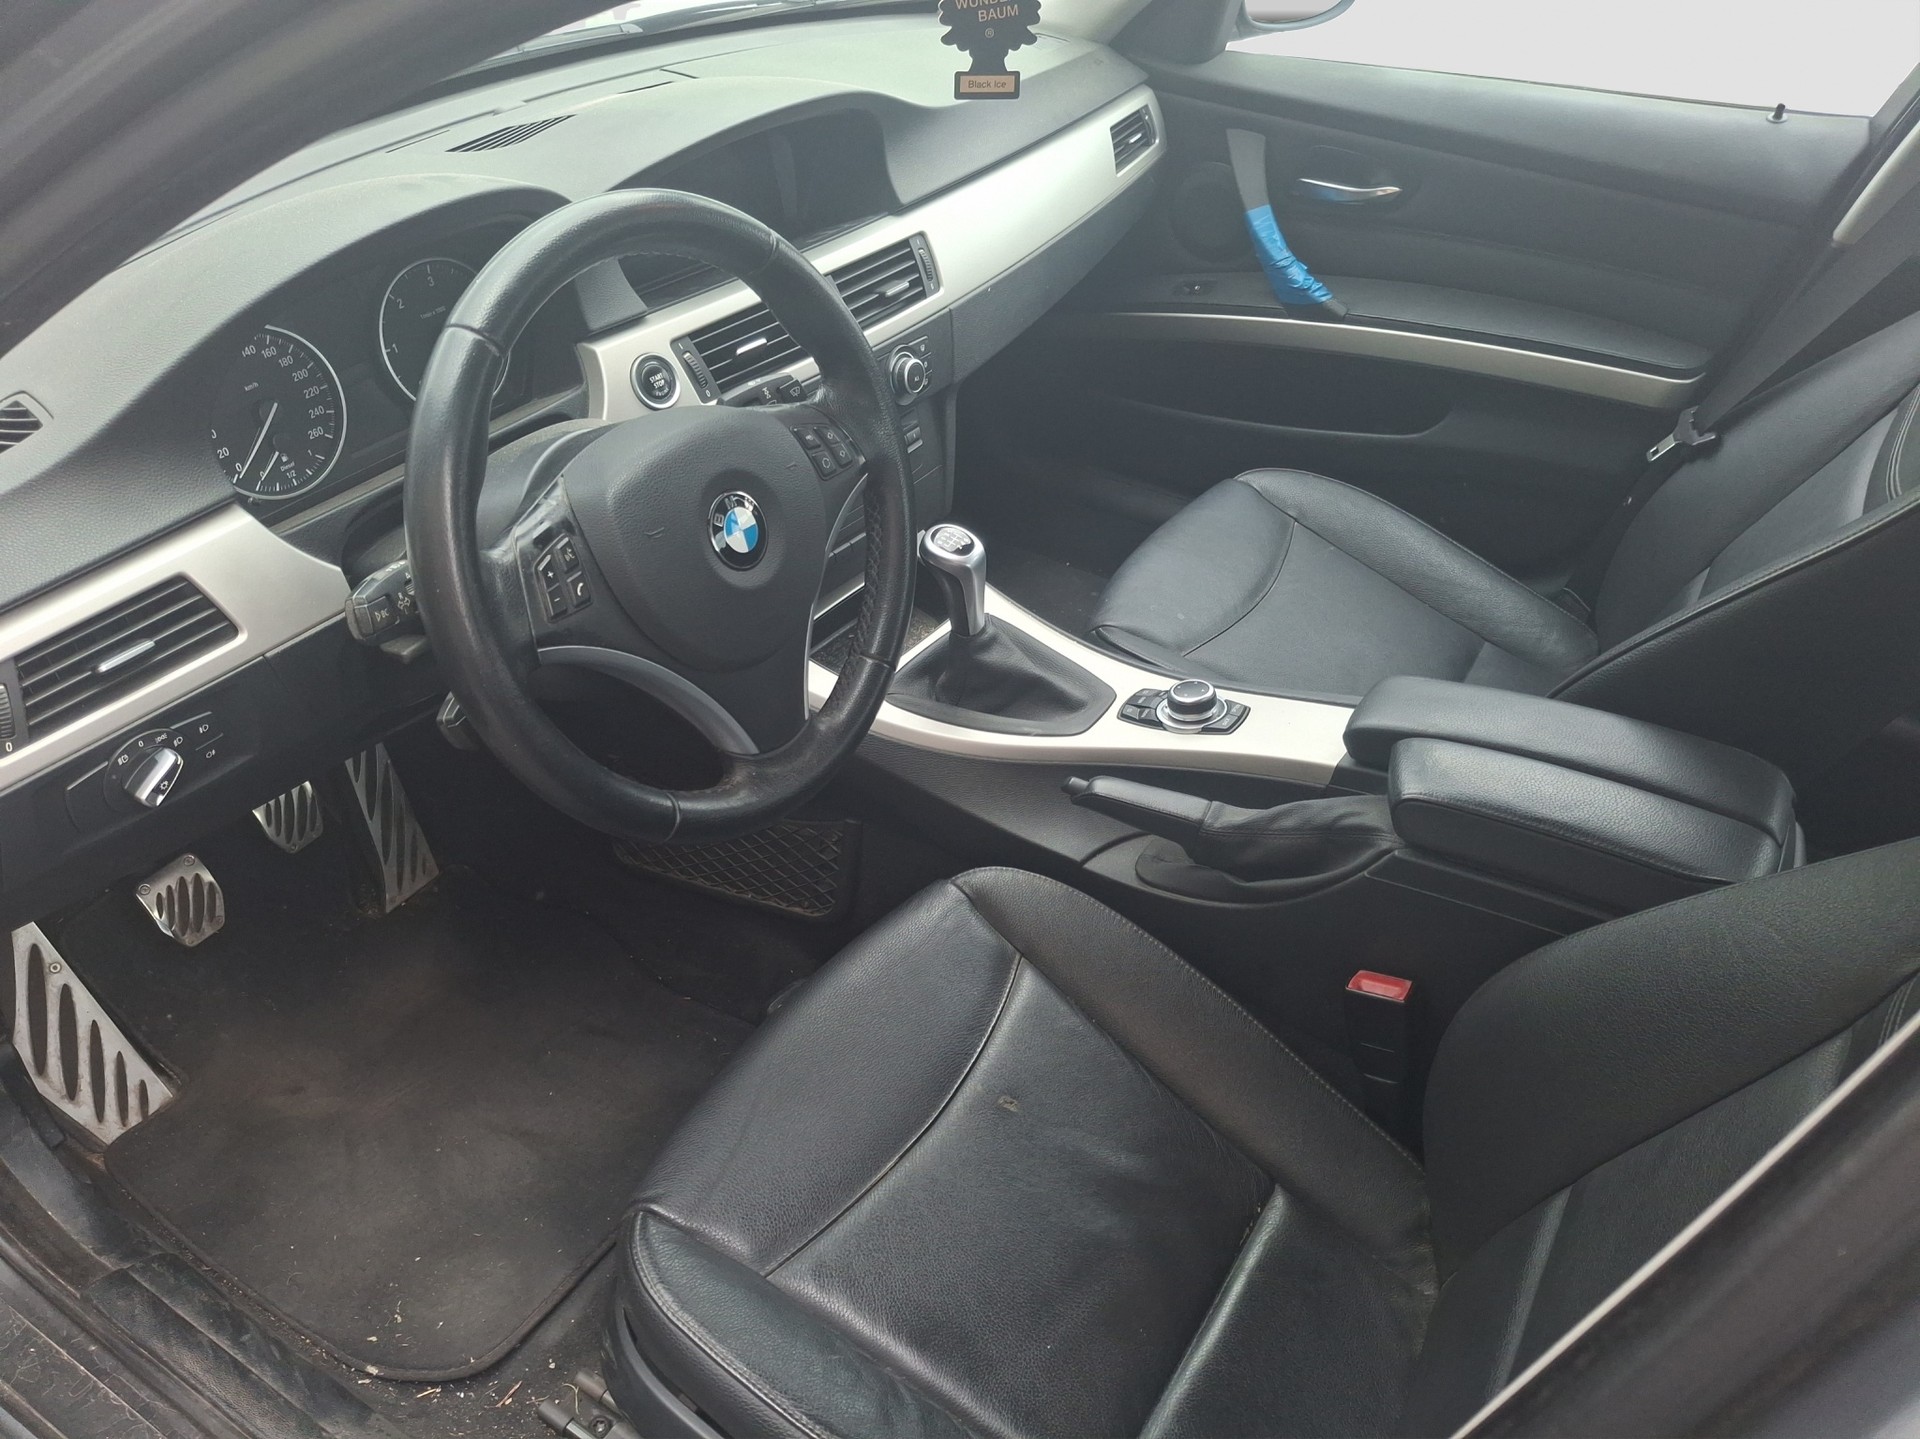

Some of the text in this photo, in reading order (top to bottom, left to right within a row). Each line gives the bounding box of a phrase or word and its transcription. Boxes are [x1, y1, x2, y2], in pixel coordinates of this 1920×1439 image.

[955, 0, 1012, 10] WUN
[978, 4, 1019, 22] BAUM
[967, 79, 1007, 89] Black Ice
[427, 275, 435, 287] 3
[396, 298, 405, 309] 2
[241, 344, 257, 358] 140
[261, 345, 277, 359] 160
[392, 343, 399, 354] 1
[278, 355, 294, 368] 180
[292, 368, 309, 382] 200
[303, 385, 320, 399] 220
[308, 405, 325, 419] 240
[307, 426, 324, 440] 260
[217, 447, 230, 459] 20
[235, 462, 243, 472] 0
[713, 495, 755, 528] BMW
[5, 741, 13, 752] 0
